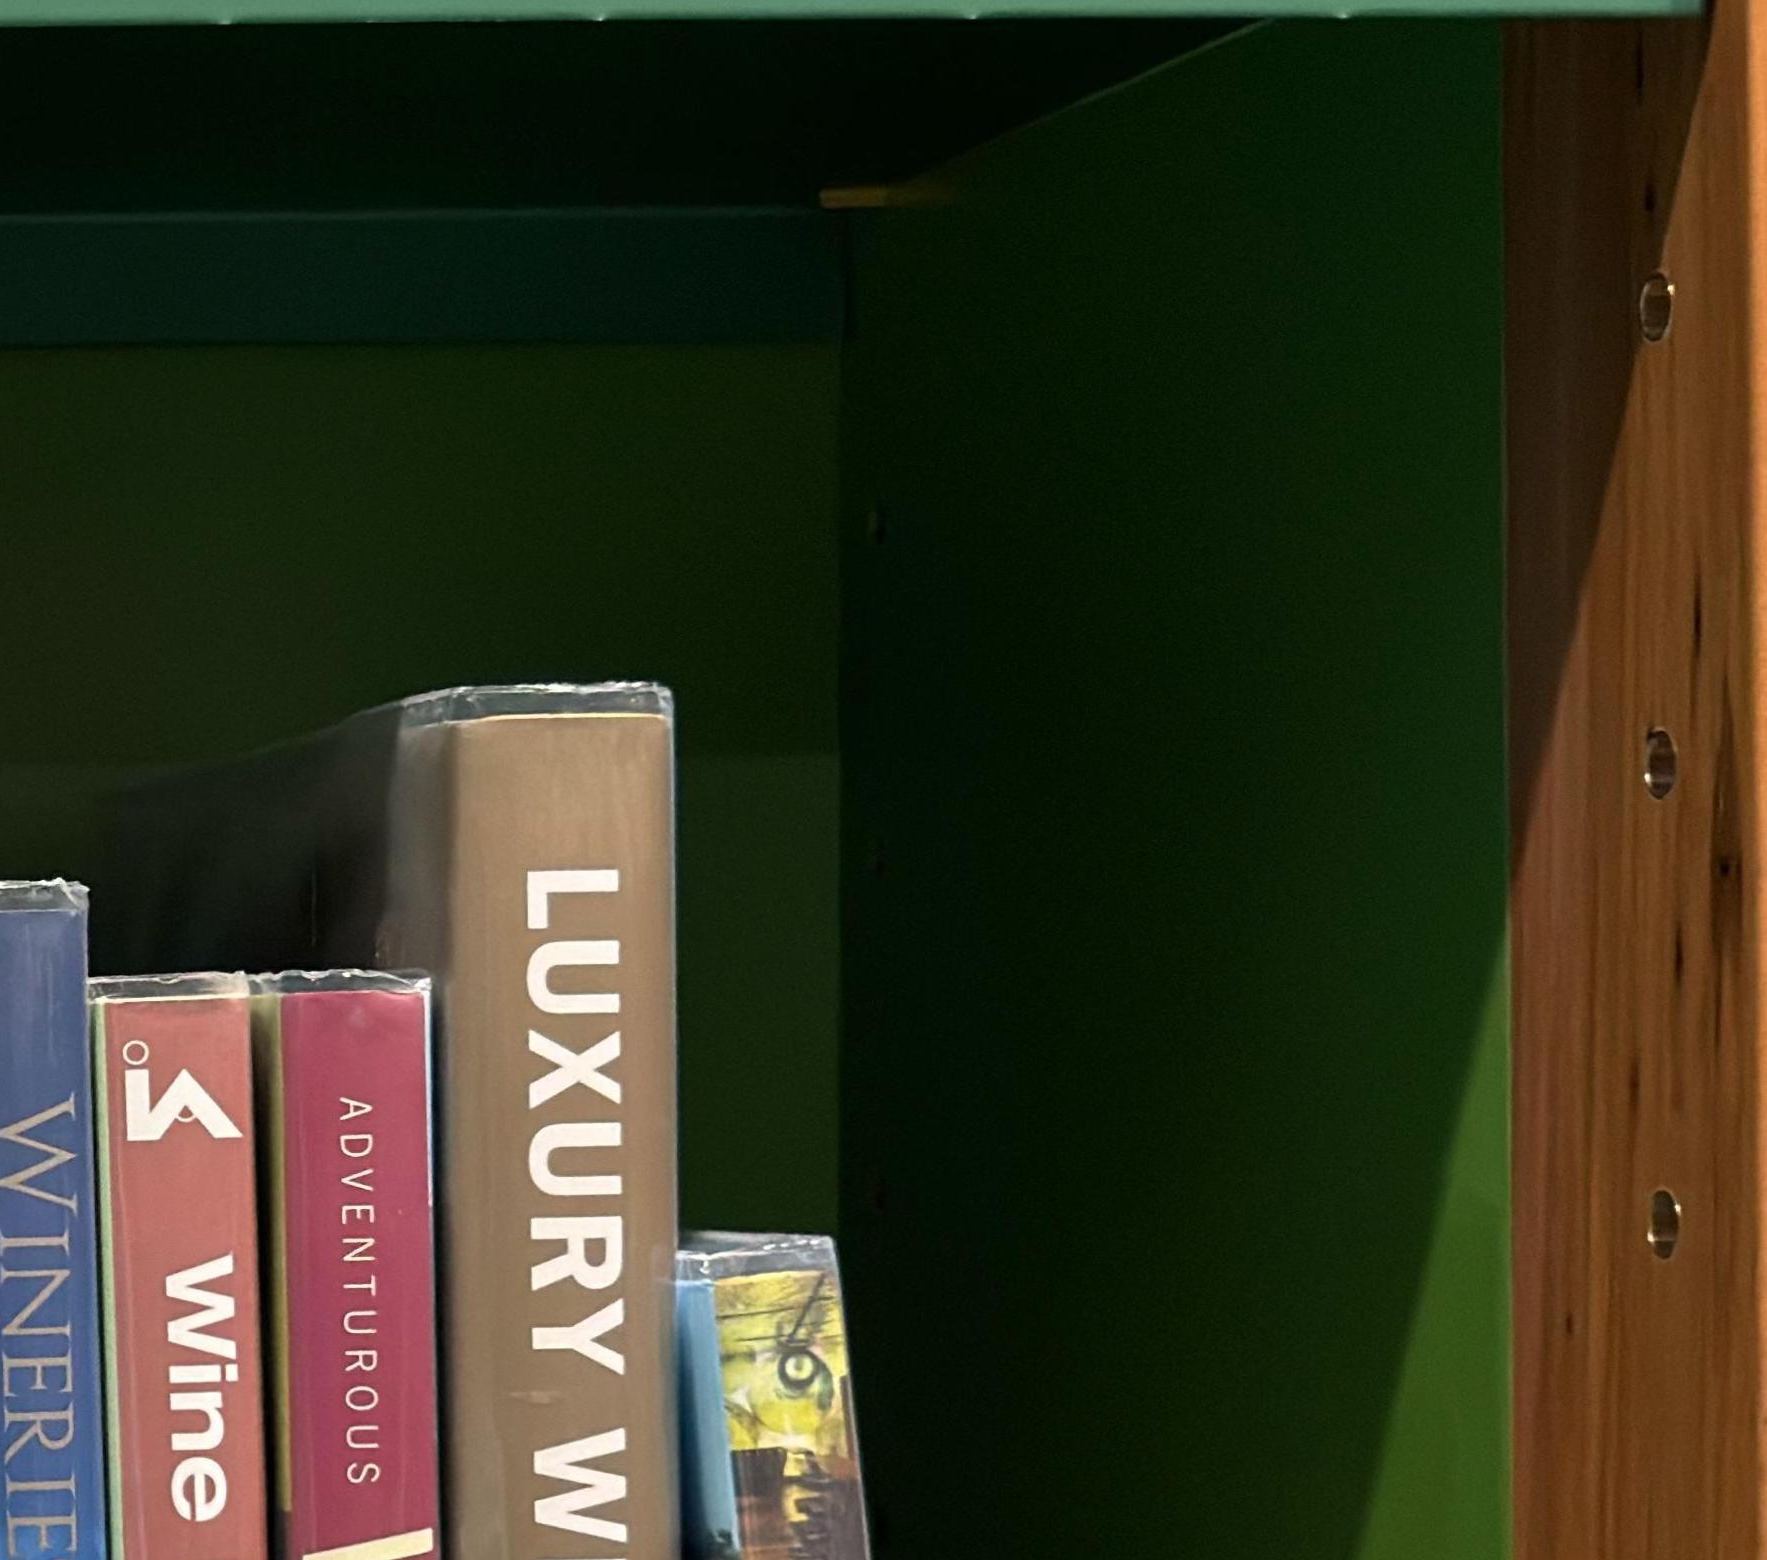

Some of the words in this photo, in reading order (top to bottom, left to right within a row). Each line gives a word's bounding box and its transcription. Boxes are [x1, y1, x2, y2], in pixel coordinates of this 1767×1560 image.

[338, 1096, 381, 1485] ADVENTUROUS
[525, 869, 626, 1376] LUXURY
[165, 1251, 240, 1523] Wine
